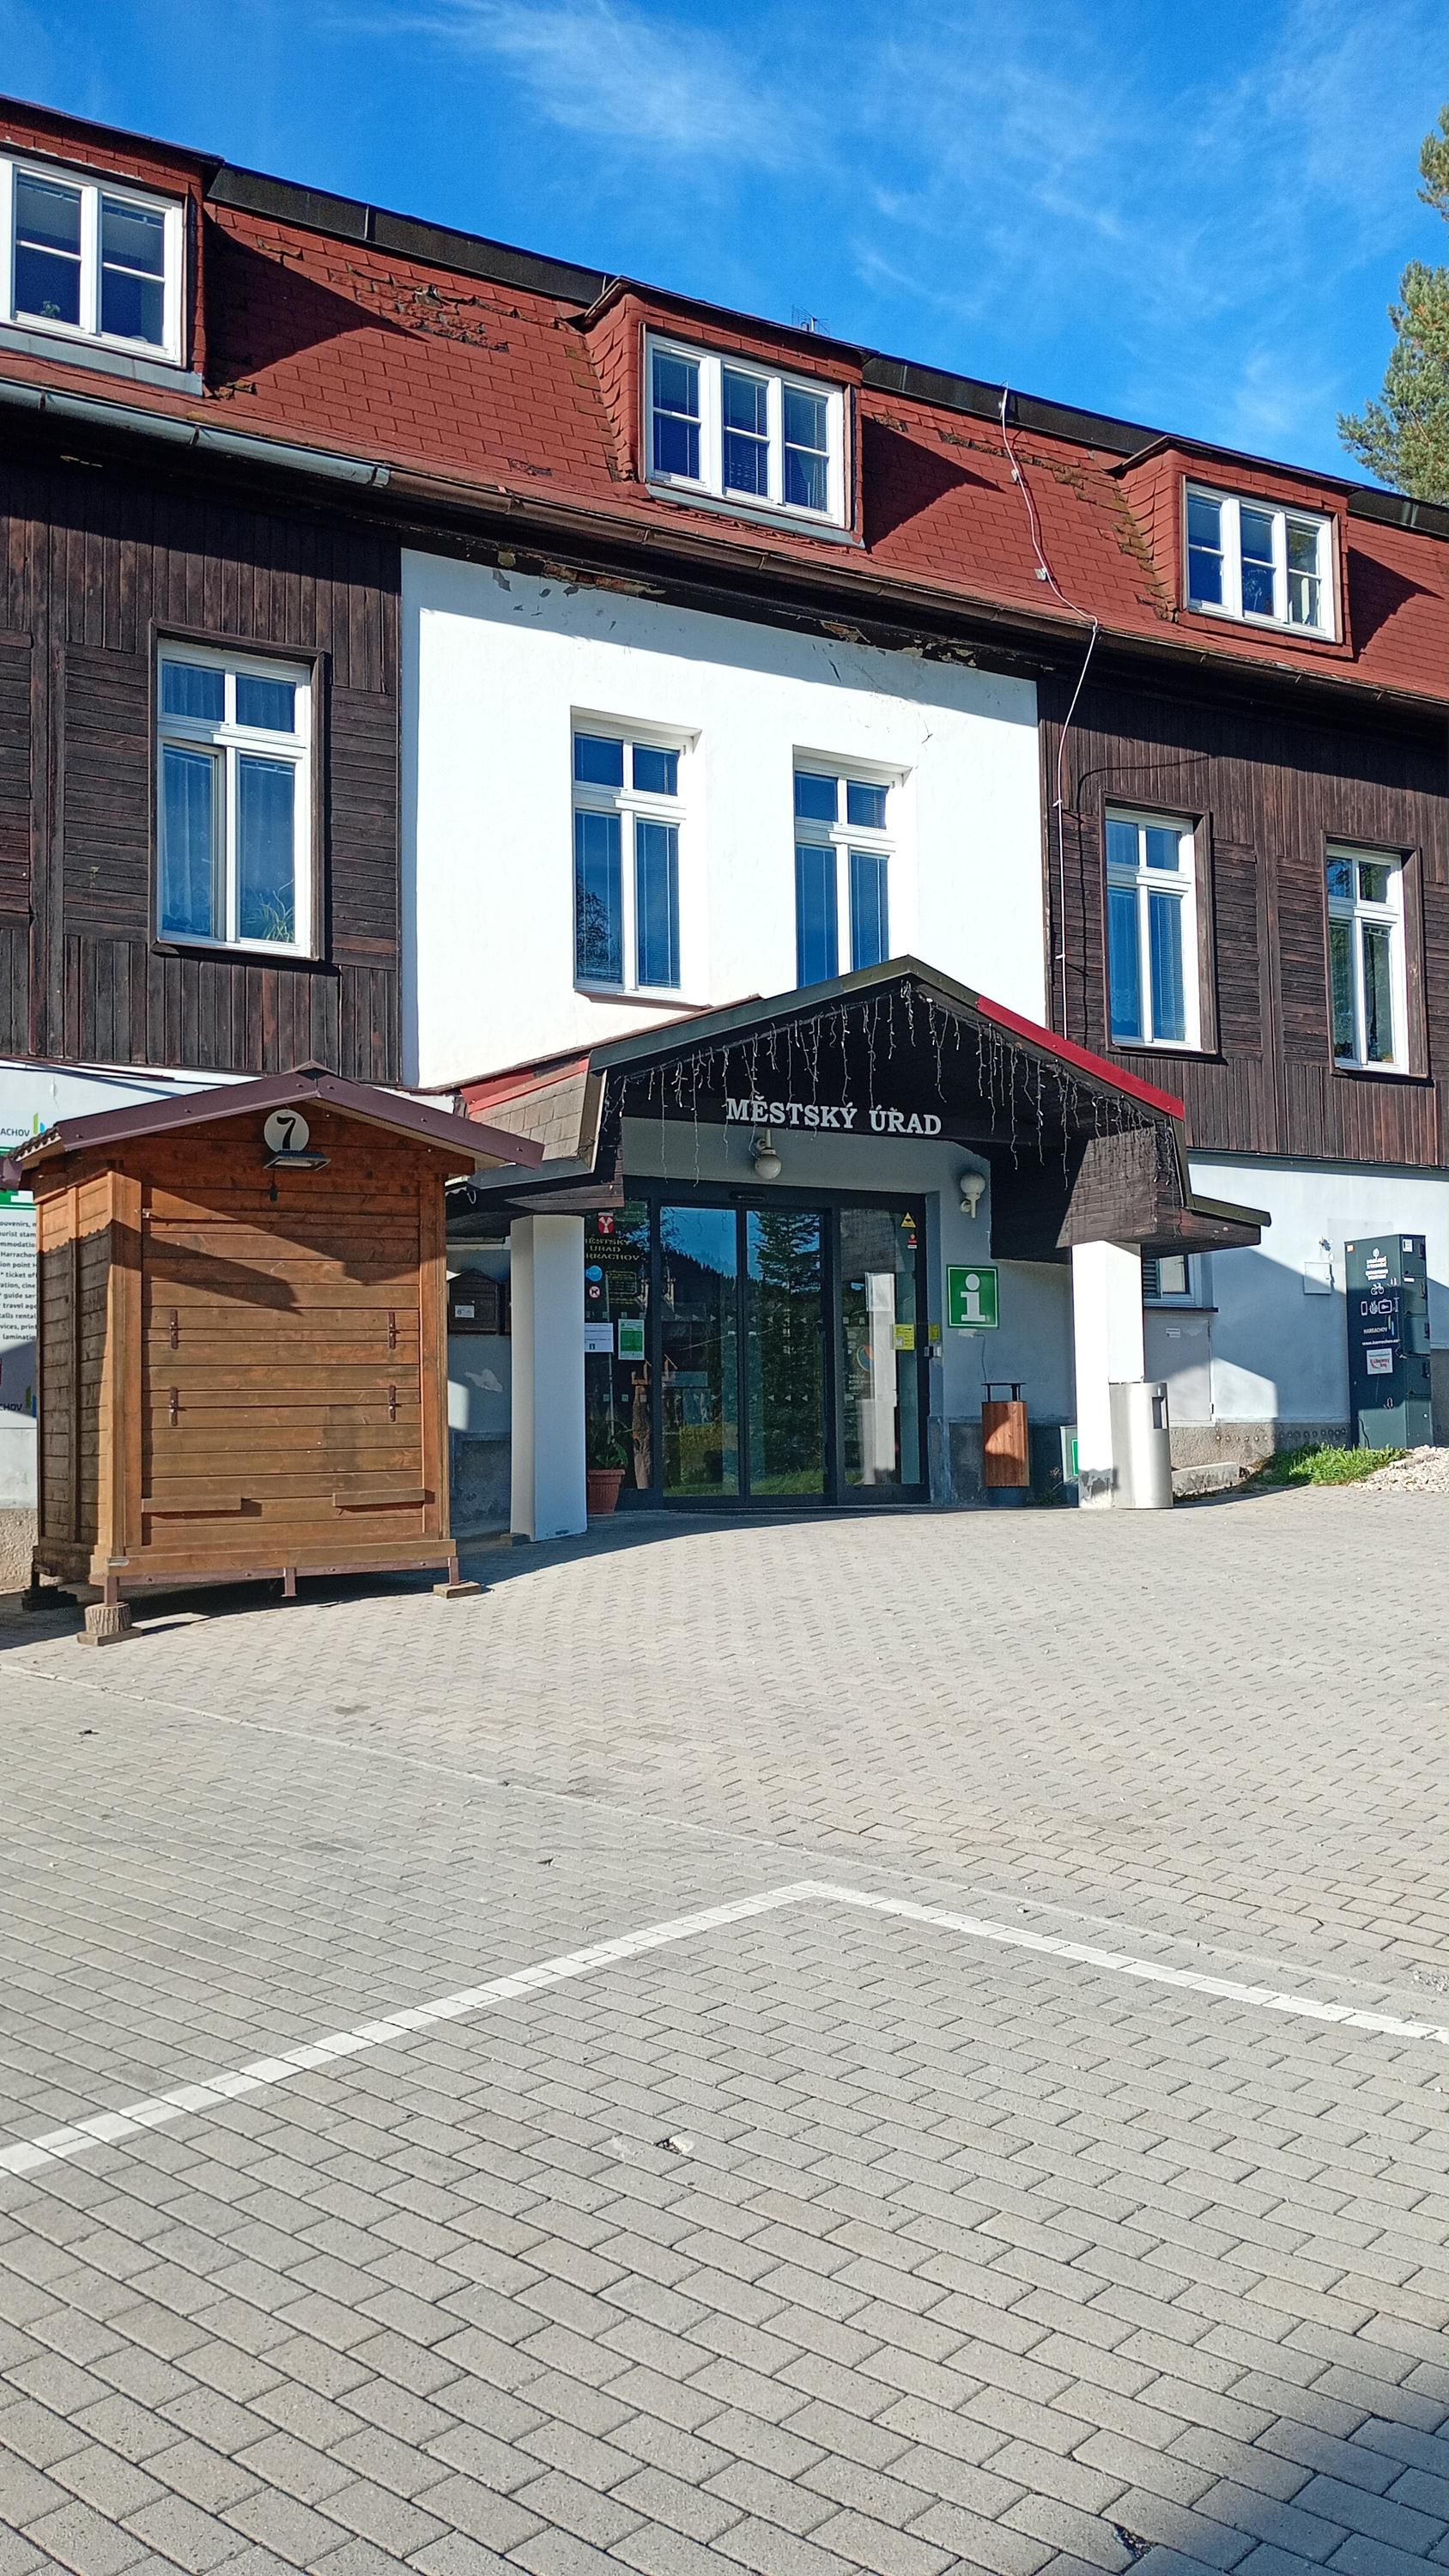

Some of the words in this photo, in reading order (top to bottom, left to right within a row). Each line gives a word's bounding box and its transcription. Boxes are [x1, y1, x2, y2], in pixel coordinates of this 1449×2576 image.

[0, 1127, 30, 1137] ACHOV
[725, 1095, 858, 1129] MĚSTSKÝ
[869, 1104, 942, 1135] ÚŘAD
[276, 1116, 296, 1150] 7
